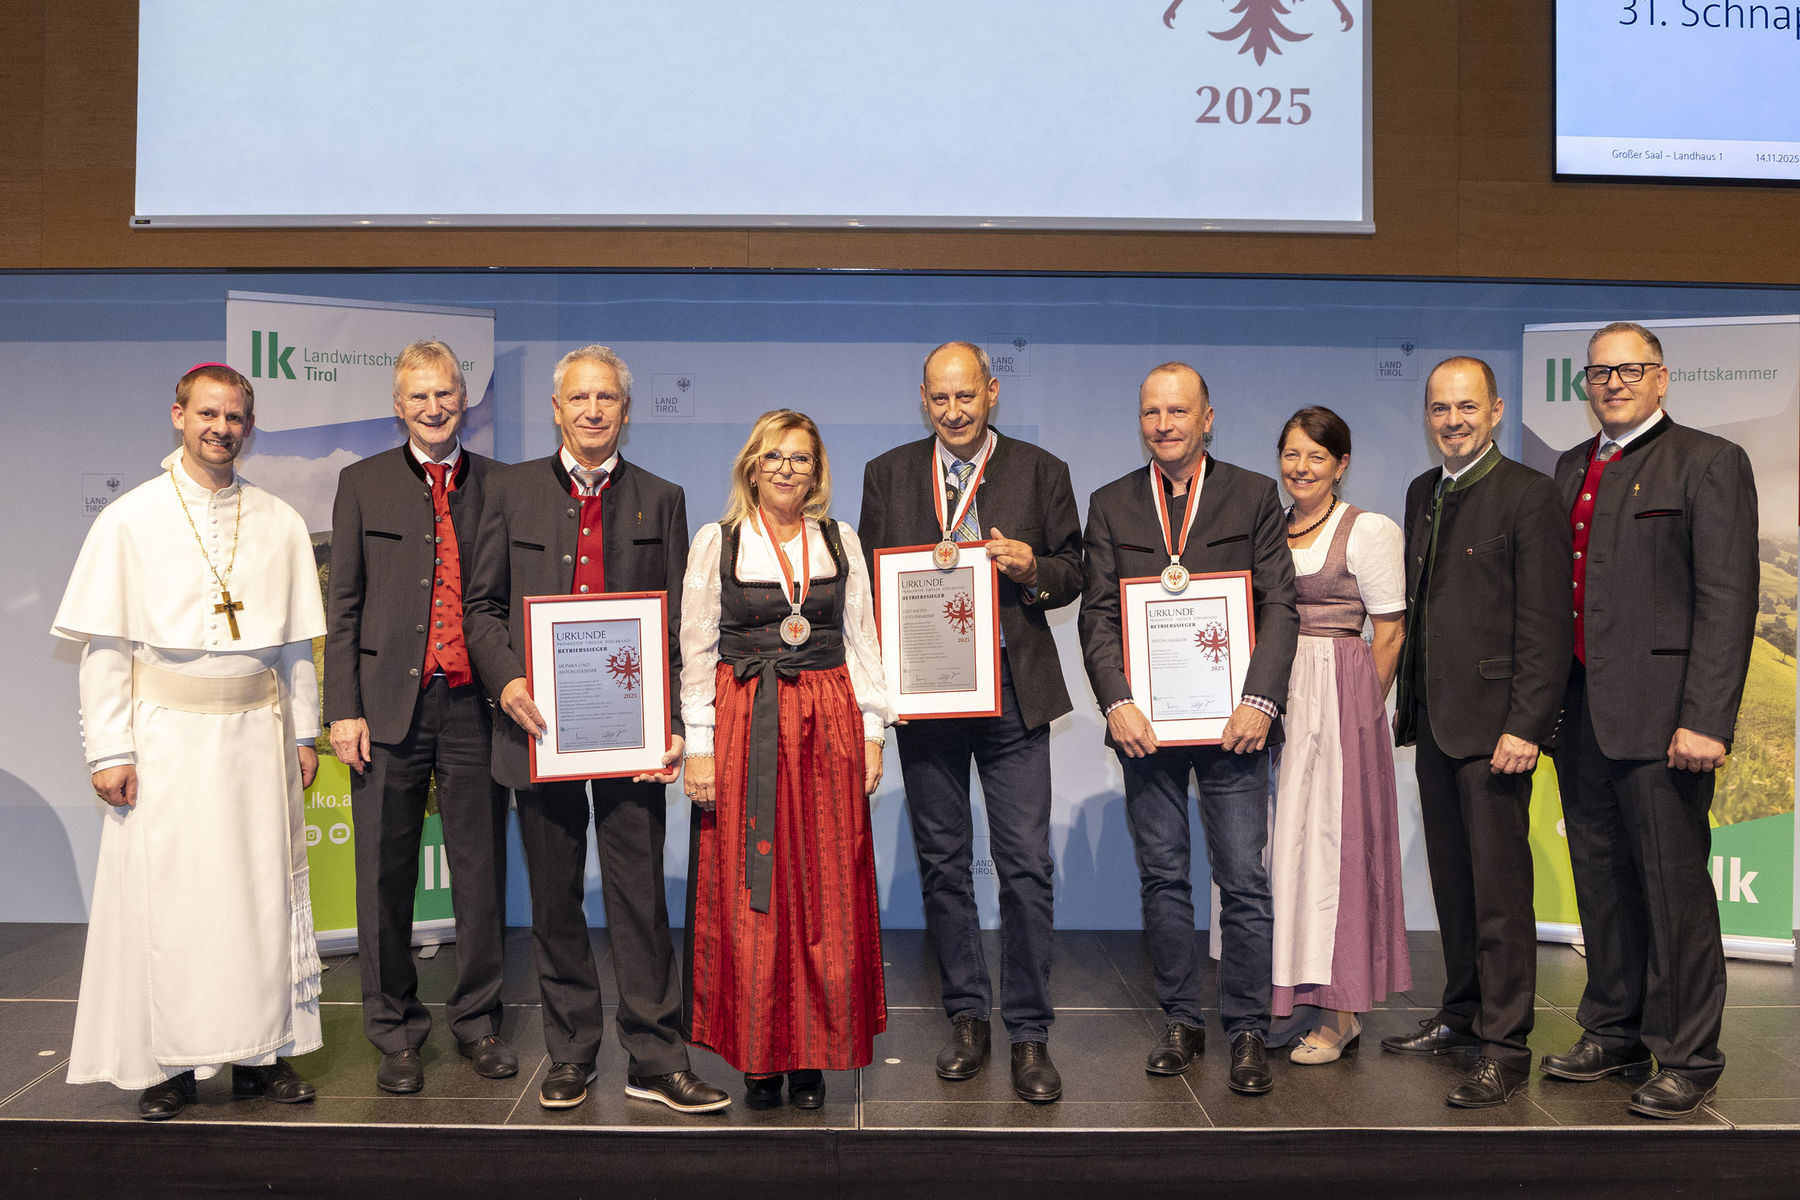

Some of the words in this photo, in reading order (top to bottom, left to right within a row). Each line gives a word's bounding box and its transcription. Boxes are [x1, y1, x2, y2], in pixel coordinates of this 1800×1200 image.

[1619, 0, 1667, 26] 31.
[1195, 85, 1312, 125] 2025
[1611, 149, 1643, 160] Großer
[1644, 150, 1663, 160] Saal
[1673, 151, 1717, 161] Landhaus
[1718, 152, 1724, 162] 1
[1755, 153, 1800, 164] 14.11.2025
[251, 330, 297, 380] lk
[991, 356, 1015, 365] LAND
[1379, 361, 1402, 369] LAND
[991, 364, 1015, 373] TIROL
[1379, 368, 1404, 377] TIROL
[304, 366, 338, 382] Tirol
[655, 397, 678, 405] LAND
[655, 405, 680, 413] TIROL
[85, 497, 108, 505] LAND
[85, 505, 106, 513] TIRO
[901, 578, 944, 589] URKUNDE
[1149, 607, 1195, 618] URKUNDE
[556, 630, 607, 641] URKUNDE
[557, 646, 608, 654] BETRIEBSSIEGER
[970, 867, 995, 875] TIROL
